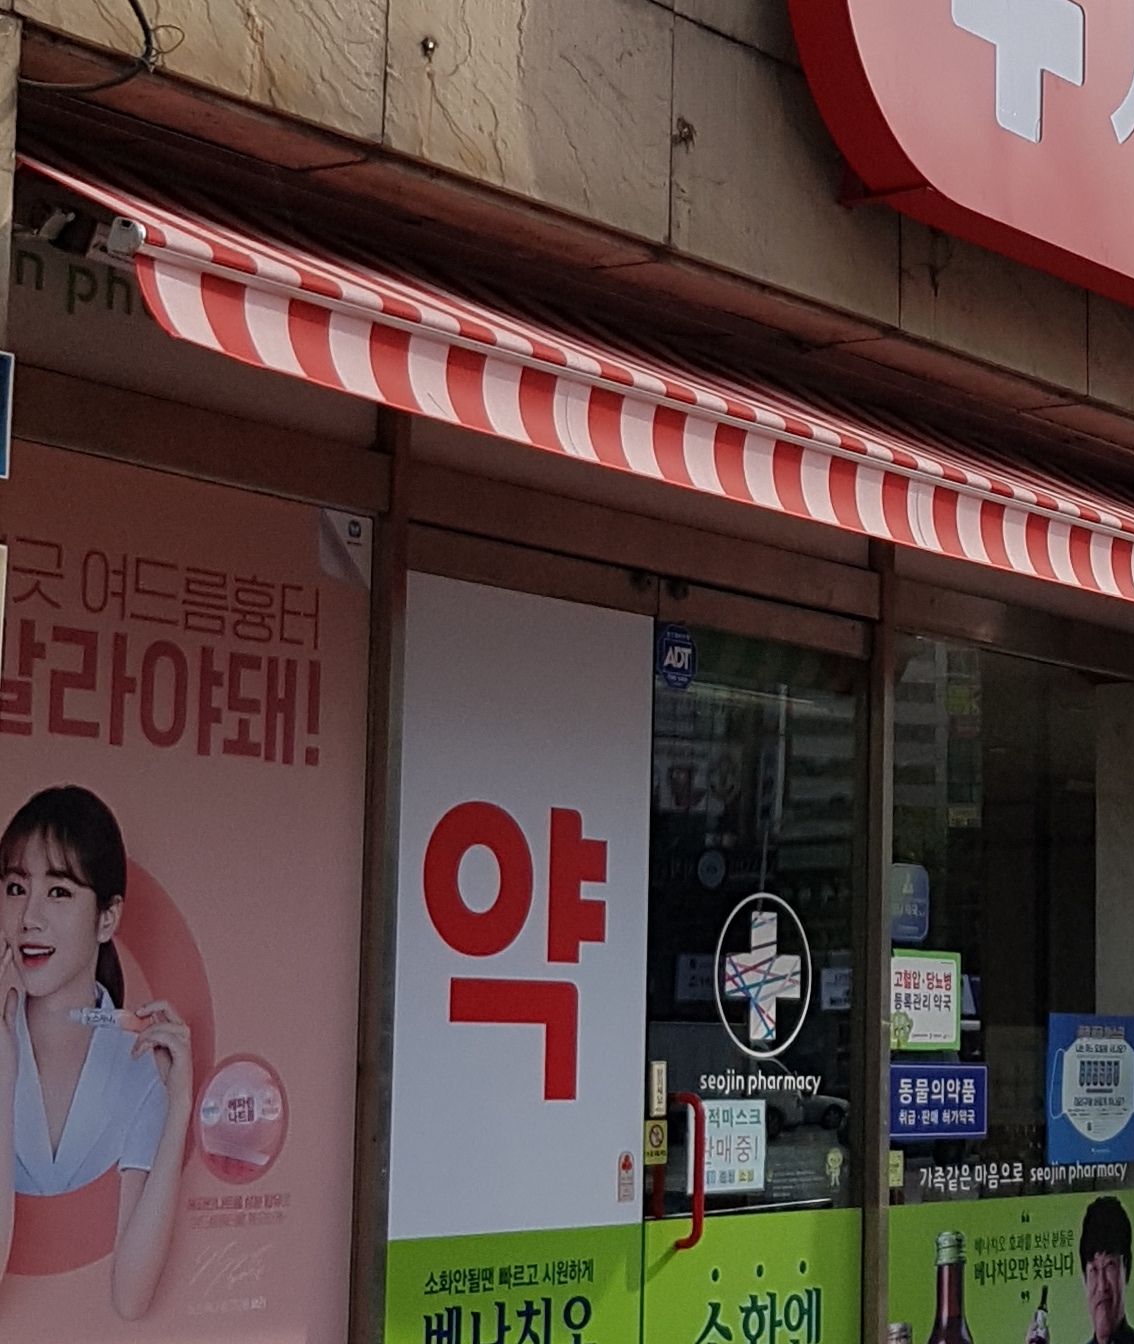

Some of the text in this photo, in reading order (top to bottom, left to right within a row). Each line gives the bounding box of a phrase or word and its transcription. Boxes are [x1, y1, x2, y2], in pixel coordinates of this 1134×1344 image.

[81, 550, 320, 652] 여드름흉터
[663, 644, 692, 670] ADT
[423, 800, 608, 1102] 약
[894, 991, 952, 1013] 등록관리 약국
[700, 1069, 822, 1096] seojin pharmacy
[898, 1077, 976, 1105] 동물의약품
[703, 1106, 763, 1129] 적마스크
[942, 1108, 976, 1125] 허가약국
[919, 1160, 1128, 1193] 가족같은 마음으로 seojin pharmacy
[1008, 1233, 1032, 1253] 효과를
[1034, 1232, 1051, 1250] 보신
[1051, 1229, 1075, 1249] 분들은
[423, 1258, 594, 1296] 소화안될땐 빠르고 시원하게
[973, 1251, 1075, 1287] 베나치오만 찾습니다
